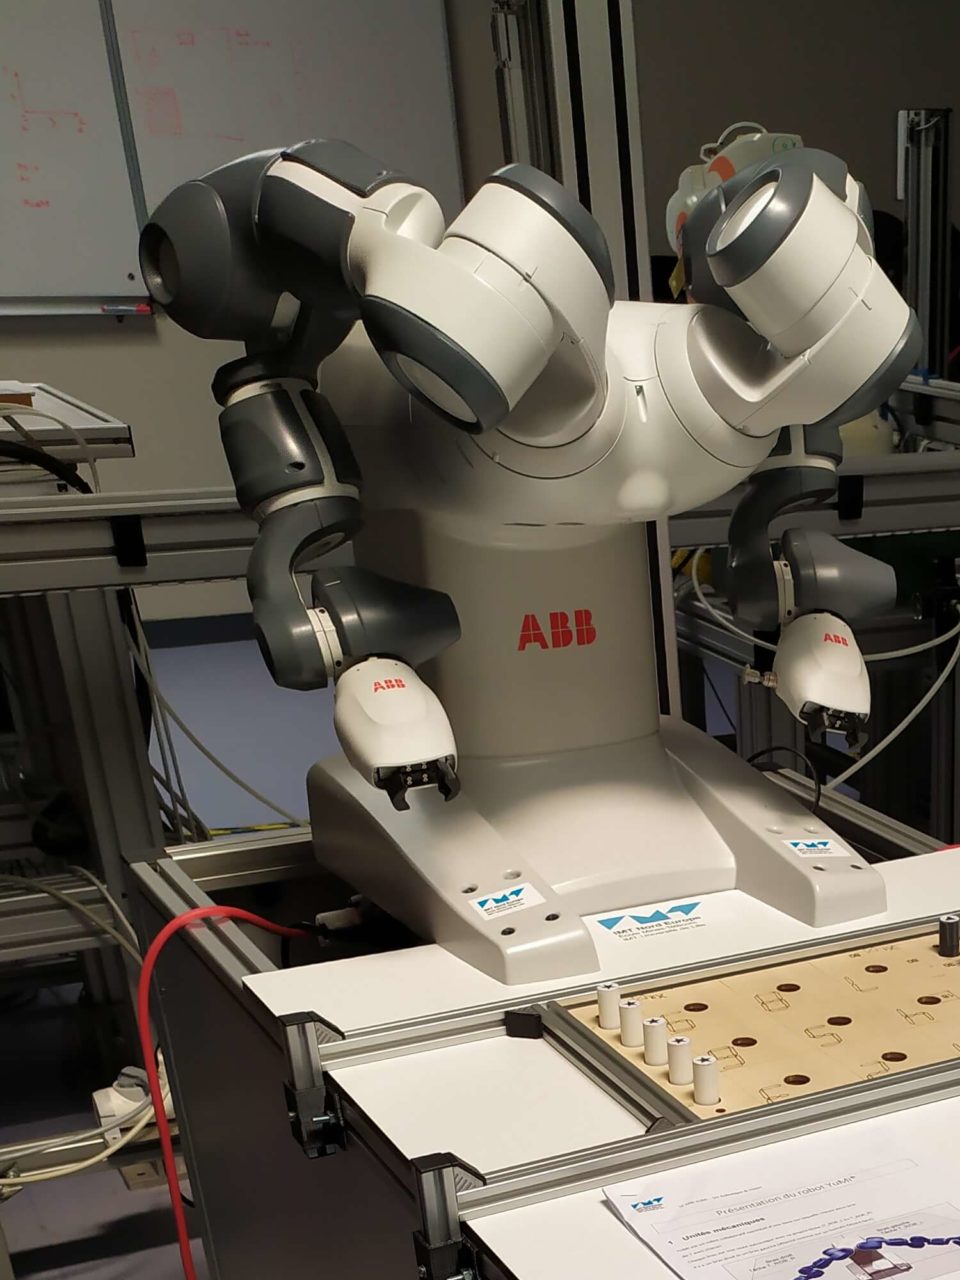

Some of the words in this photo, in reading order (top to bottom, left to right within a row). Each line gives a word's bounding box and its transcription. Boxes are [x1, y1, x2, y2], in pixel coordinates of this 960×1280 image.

[517, 609, 597, 652] ABB
[824, 632, 849, 647] ABB
[373, 678, 406, 693] ABB
[715, 1195, 782, 1216] Présentation
[783, 1191, 797, 1200] du
[798, 1184, 825, 1196] robot
[681, 1230, 711, 1241] Unités
[712, 1217, 766, 1233] mécaniques
